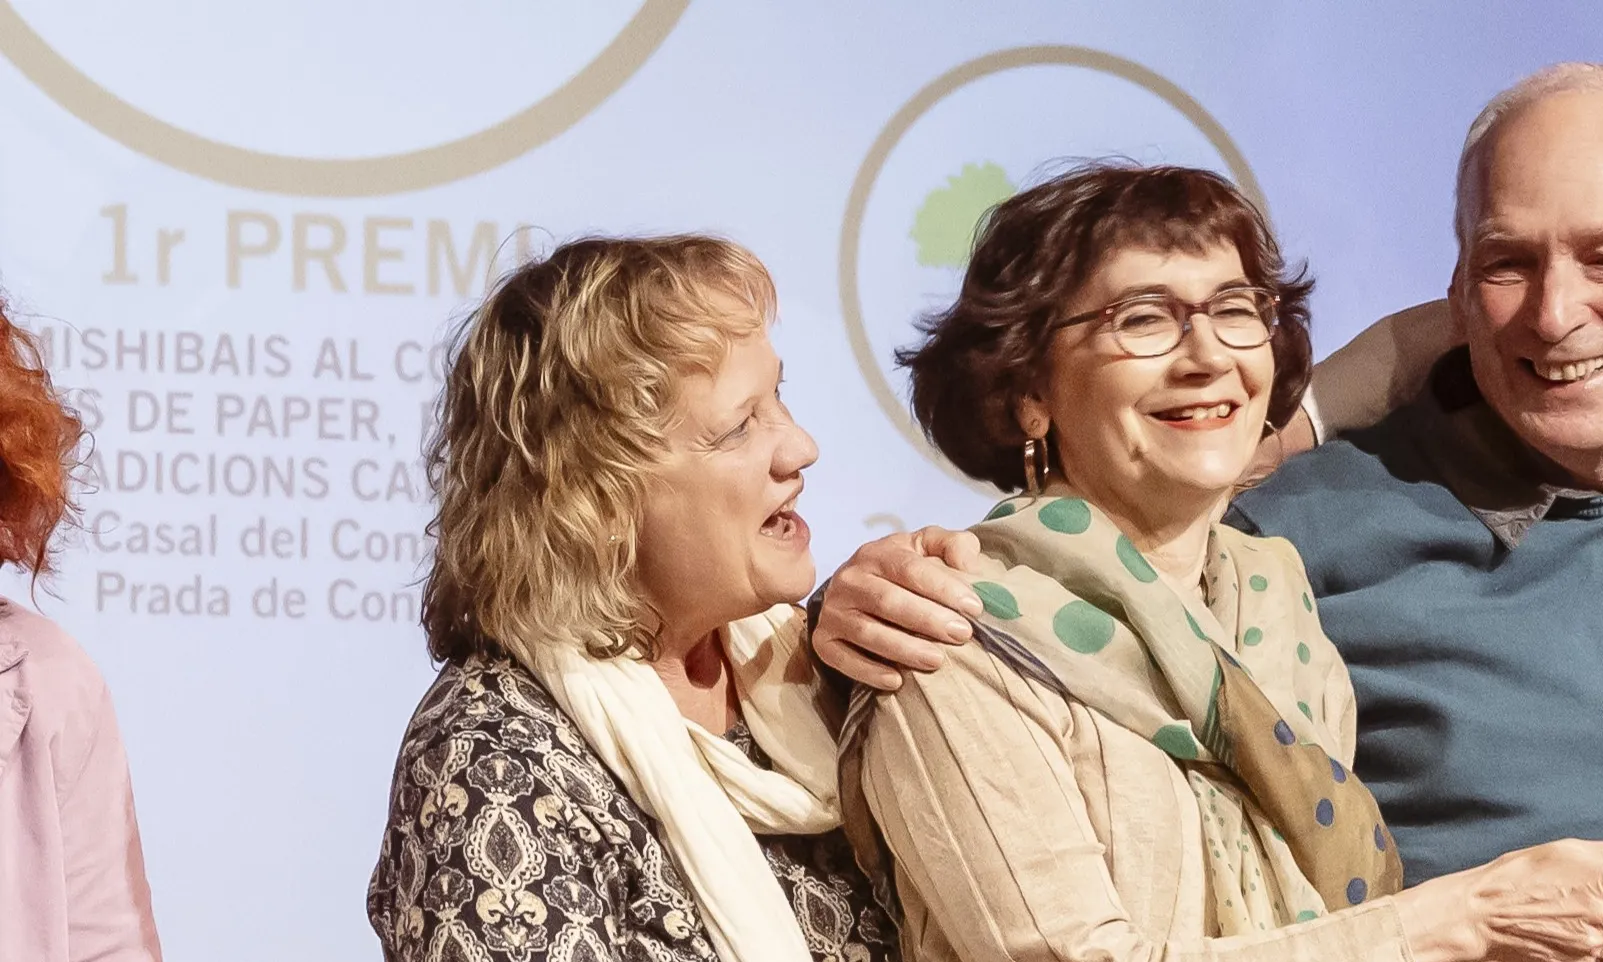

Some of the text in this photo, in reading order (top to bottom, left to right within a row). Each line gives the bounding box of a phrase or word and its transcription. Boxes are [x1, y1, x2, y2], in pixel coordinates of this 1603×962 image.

[99, 203, 186, 286] 1r
[312, 336, 376, 380] AL
[127, 389, 196, 435] DE
[216, 392, 396, 449] PAPER,
[84, 449, 330, 501] ADICIONS
[92, 509, 422, 564] Casal del Con
[95, 569, 416, 623] Prada de Con
